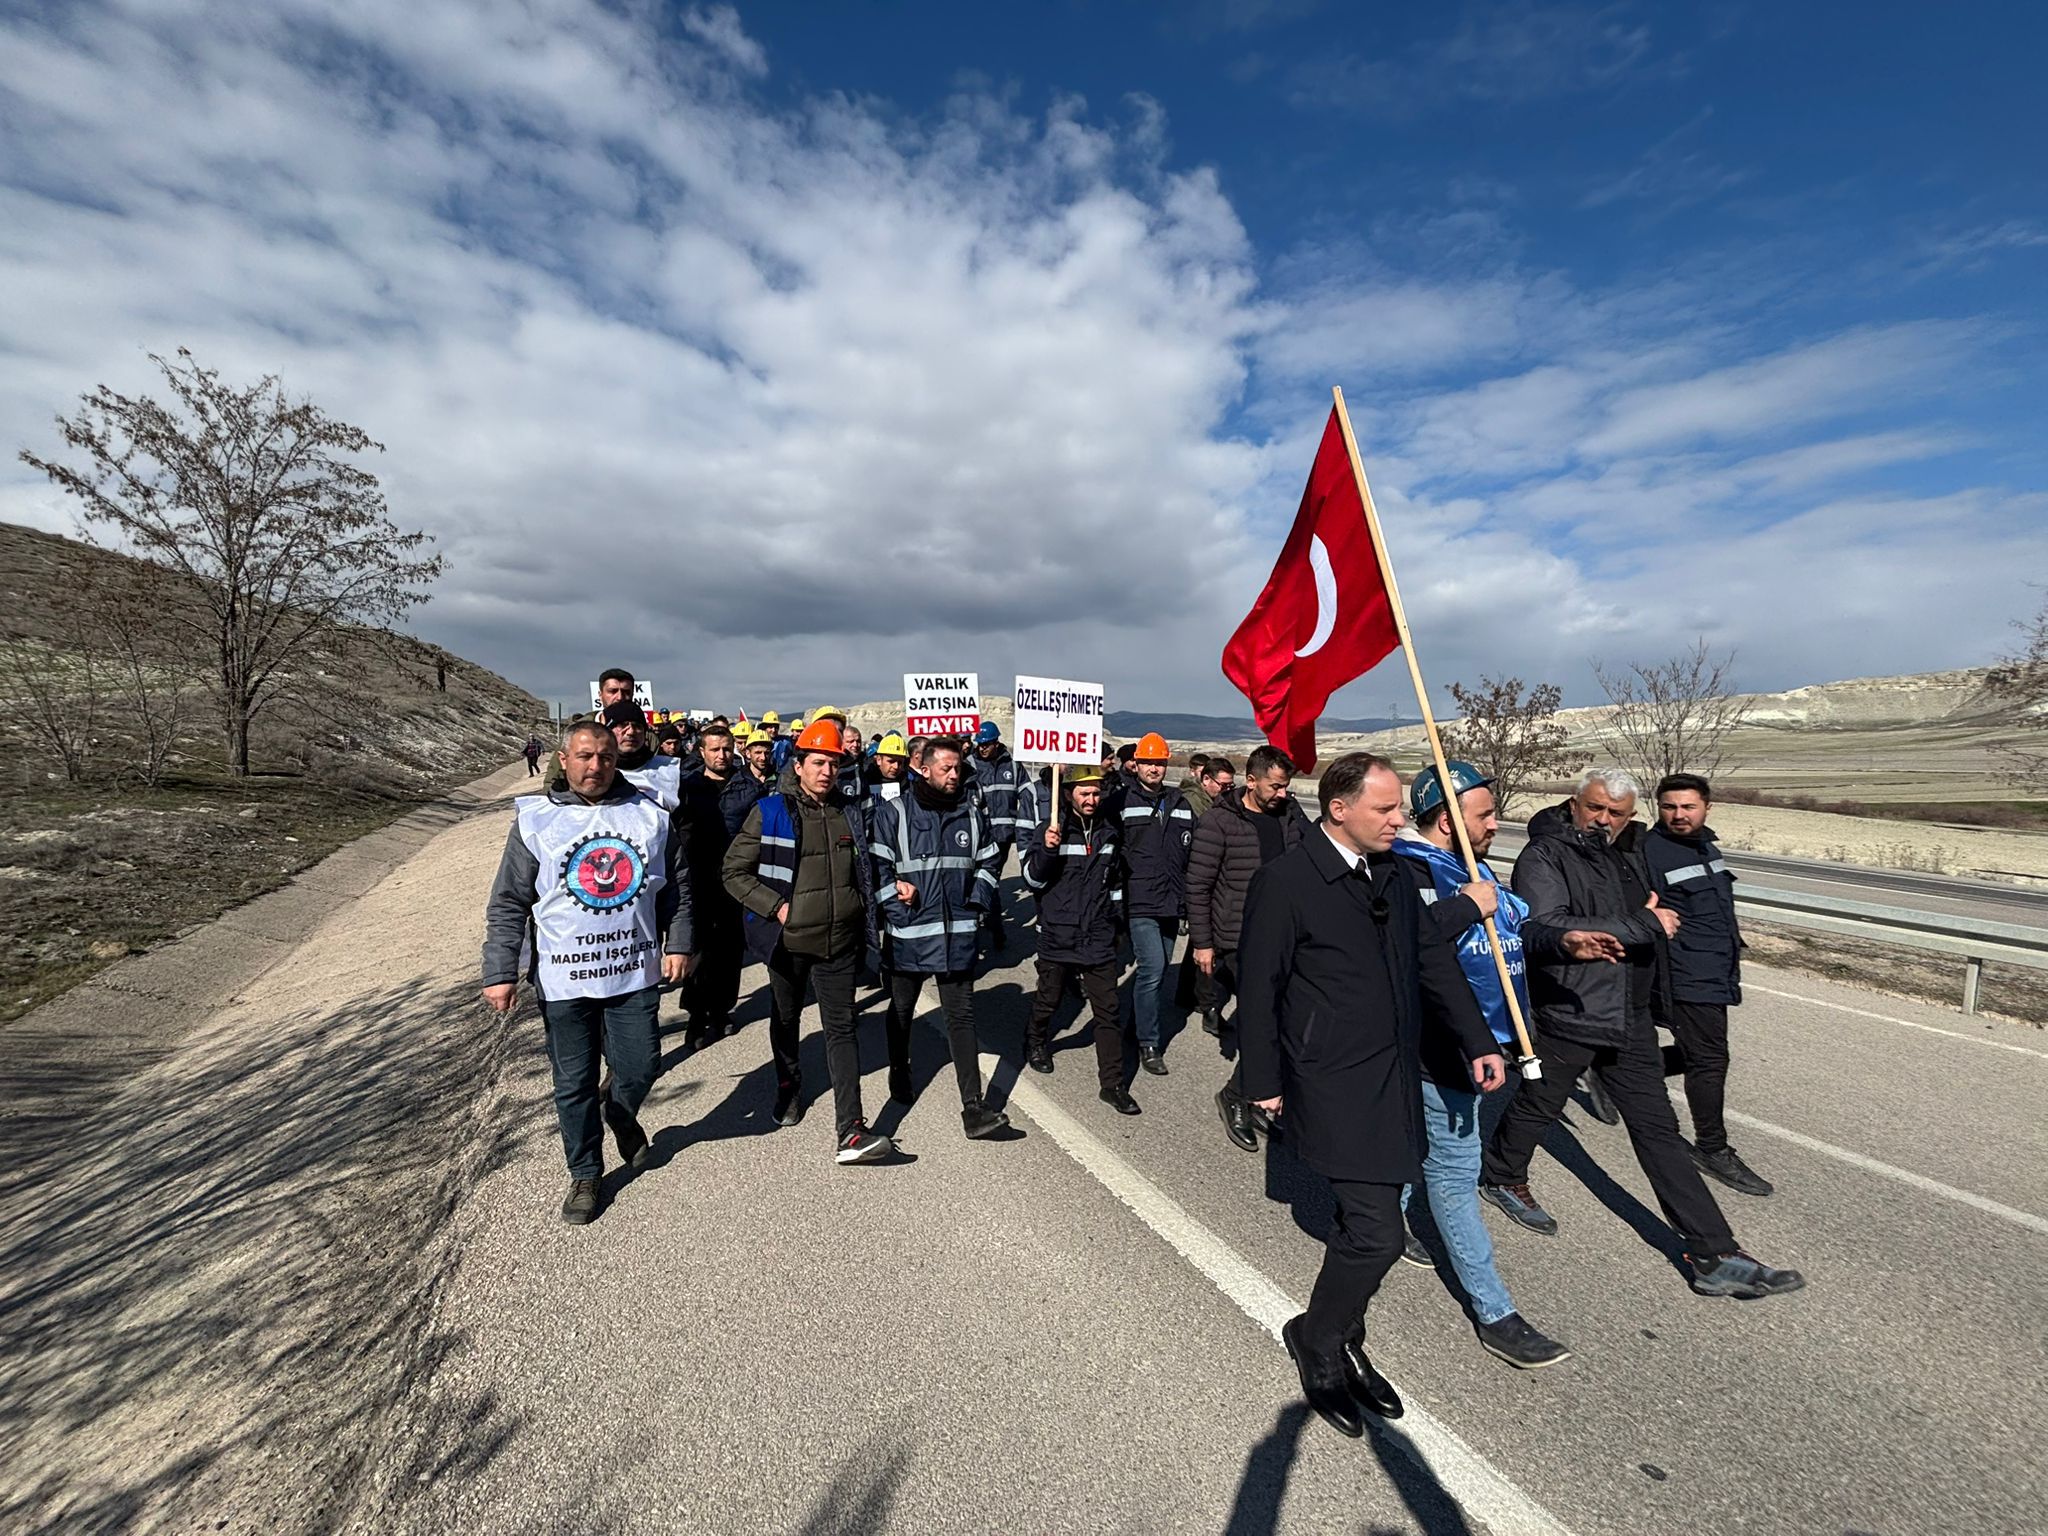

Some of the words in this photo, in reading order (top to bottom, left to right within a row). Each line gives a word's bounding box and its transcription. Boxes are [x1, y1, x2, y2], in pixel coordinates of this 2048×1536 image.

[914, 677, 969, 691] VARLIK
[908, 696, 977, 713] SATIŞINA
[1017, 683, 1103, 719] ÖZELLEŞTİRMEYE
[913, 717, 975, 735] HAYIR
[1023, 728, 1060, 752] DUR
[1066, 731, 1087, 753] DE
[1092, 733, 1097, 754] !
[575, 927, 639, 946] TÜRKİYE
[551, 951, 601, 964] MADEN
[606, 939, 657, 961] İŞÇİLERİ
[569, 959, 645, 981] SENDİKASI
